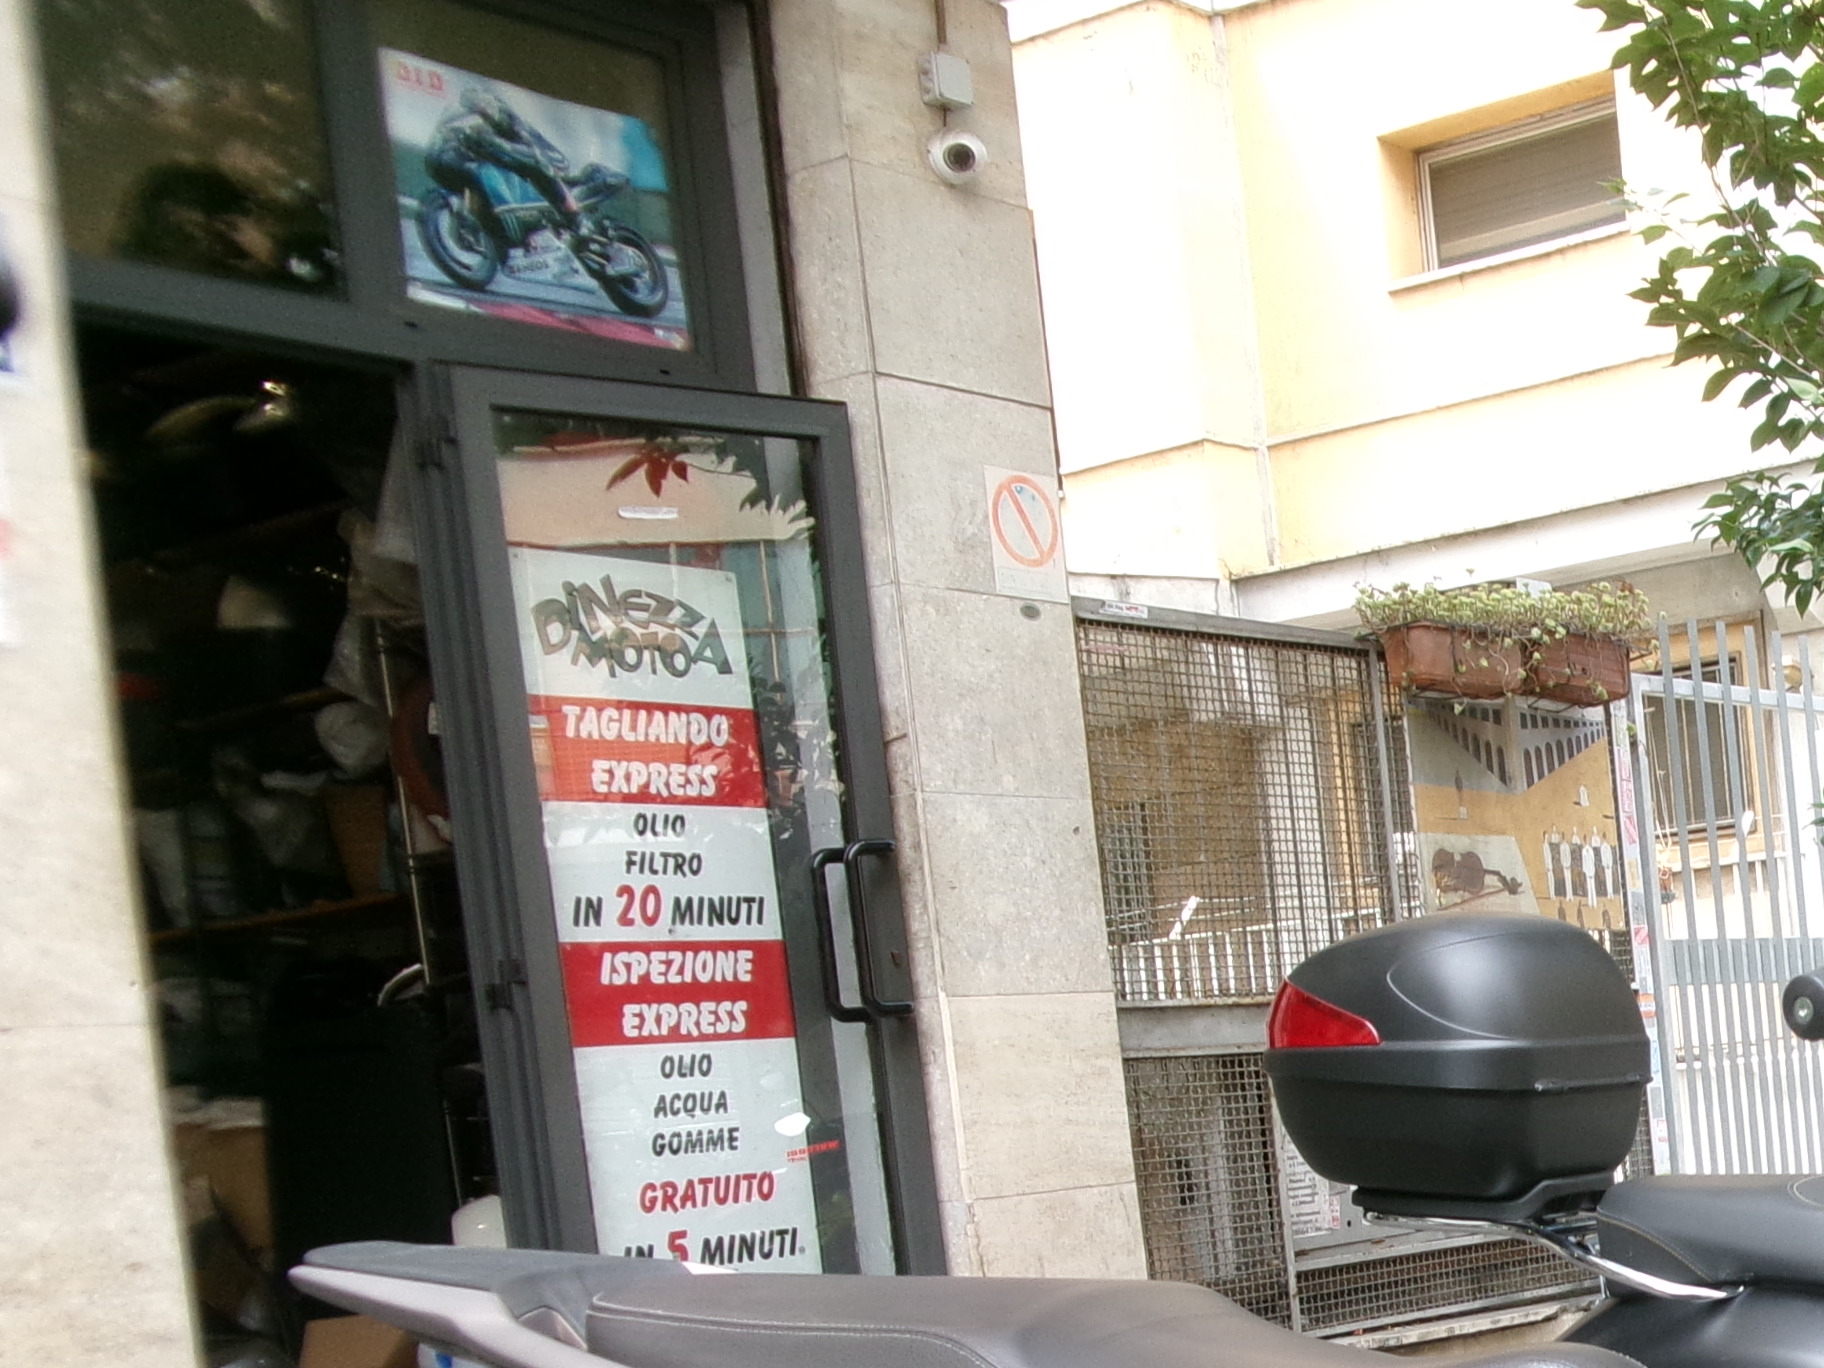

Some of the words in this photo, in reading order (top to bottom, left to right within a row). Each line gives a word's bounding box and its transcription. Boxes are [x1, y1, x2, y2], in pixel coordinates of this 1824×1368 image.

[570, 626, 692, 678] MOTO
[562, 705, 729, 746] TAGLIANDO
[591, 759, 718, 797] EXPRESS
[633, 812, 686, 837] OLIO
[625, 850, 702, 878] FILTRO
[573, 896, 603, 927] IN
[615, 884, 662, 927] 20
[671, 896, 764, 927] MINUTI
[601, 950, 754, 985] ISPEZIONE
[622, 1000, 748, 1037] EXPRESS
[660, 1053, 713, 1079] OLIO
[653, 1090, 729, 1119] ACQUA
[652, 1127, 740, 1157] GOMME
[640, 1170, 775, 1214] GRATUITO
[667, 1230, 689, 1262] 5
